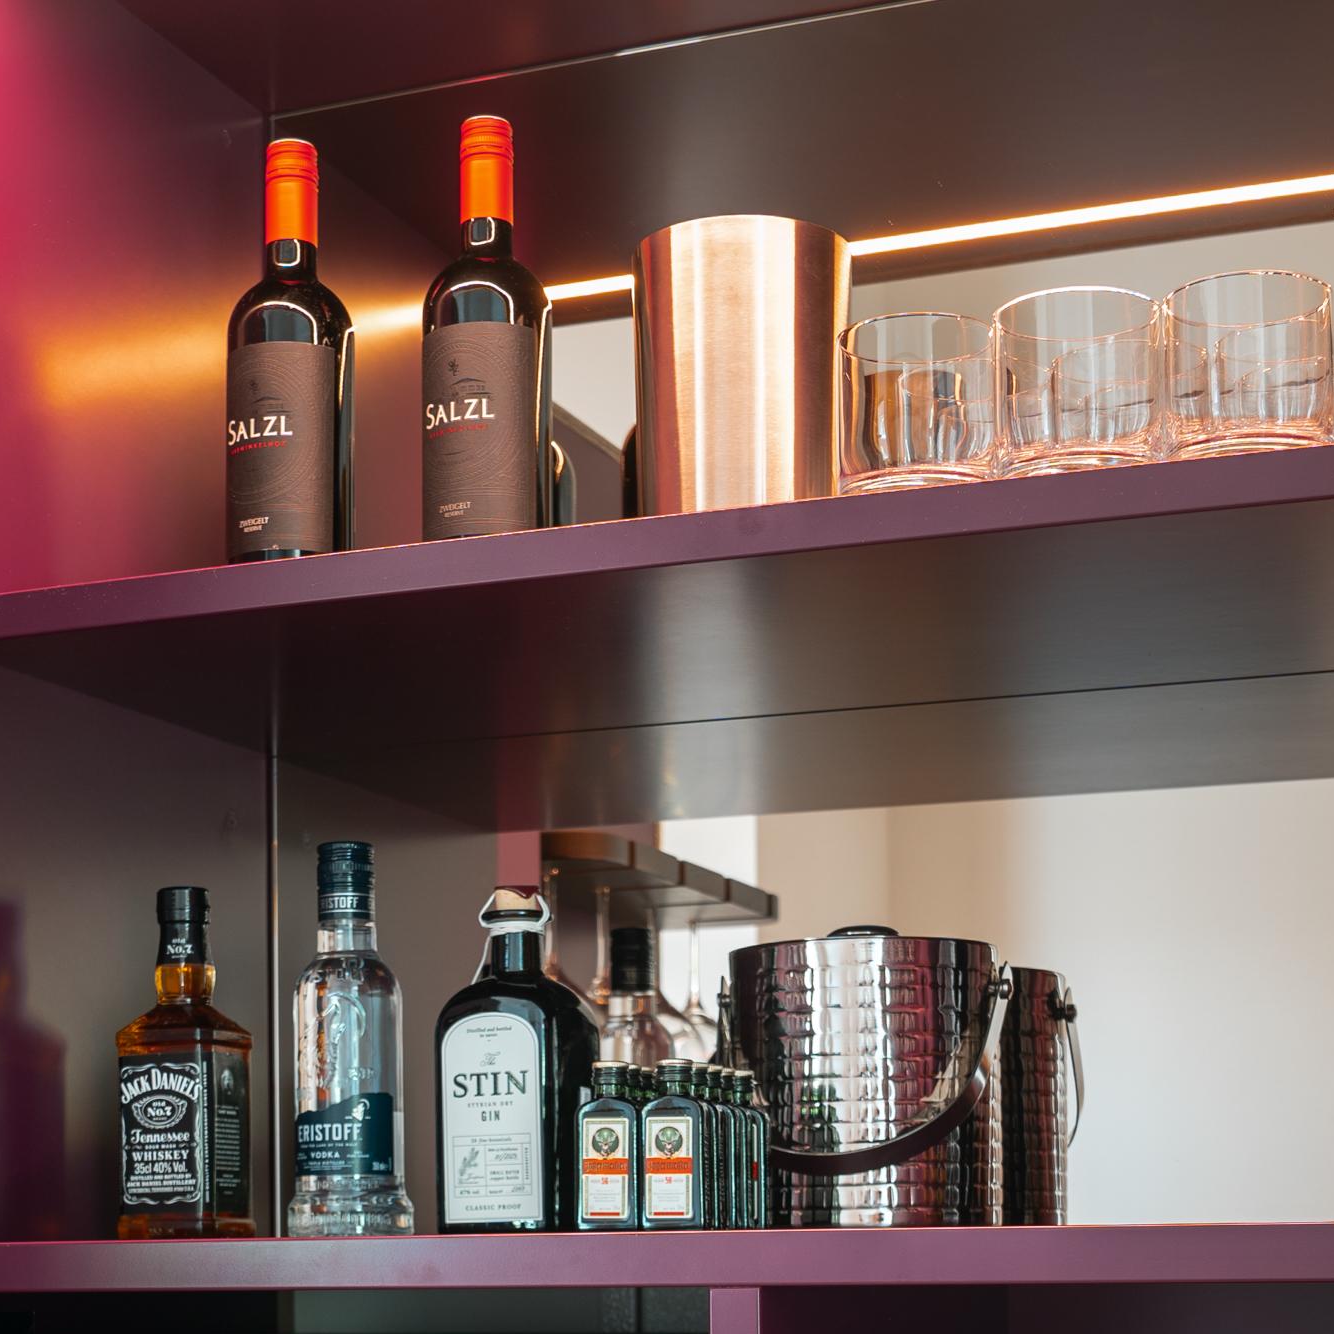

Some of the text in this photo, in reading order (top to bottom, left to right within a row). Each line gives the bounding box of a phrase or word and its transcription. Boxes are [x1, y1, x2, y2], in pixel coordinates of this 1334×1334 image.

[426, 398, 495, 430] SALZL
[228, 415, 294, 446] SALZL
[439, 501, 471, 513] ZWEIGELT
[238, 516, 269, 529] ZWEIGELT
[120, 1074, 152, 1104] JACK
[452, 1069, 529, 1098] STIN
[481, 1110, 500, 1122] GIN
[130, 1129, 190, 1144] Tennessee
[298, 1122, 363, 1143] ERISTOFF
[131, 1149, 189, 1162] WHISKEY
[310, 1151, 340, 1159] VODKA
[134, 1161, 188, 1174] 35cl 40% Vol.
